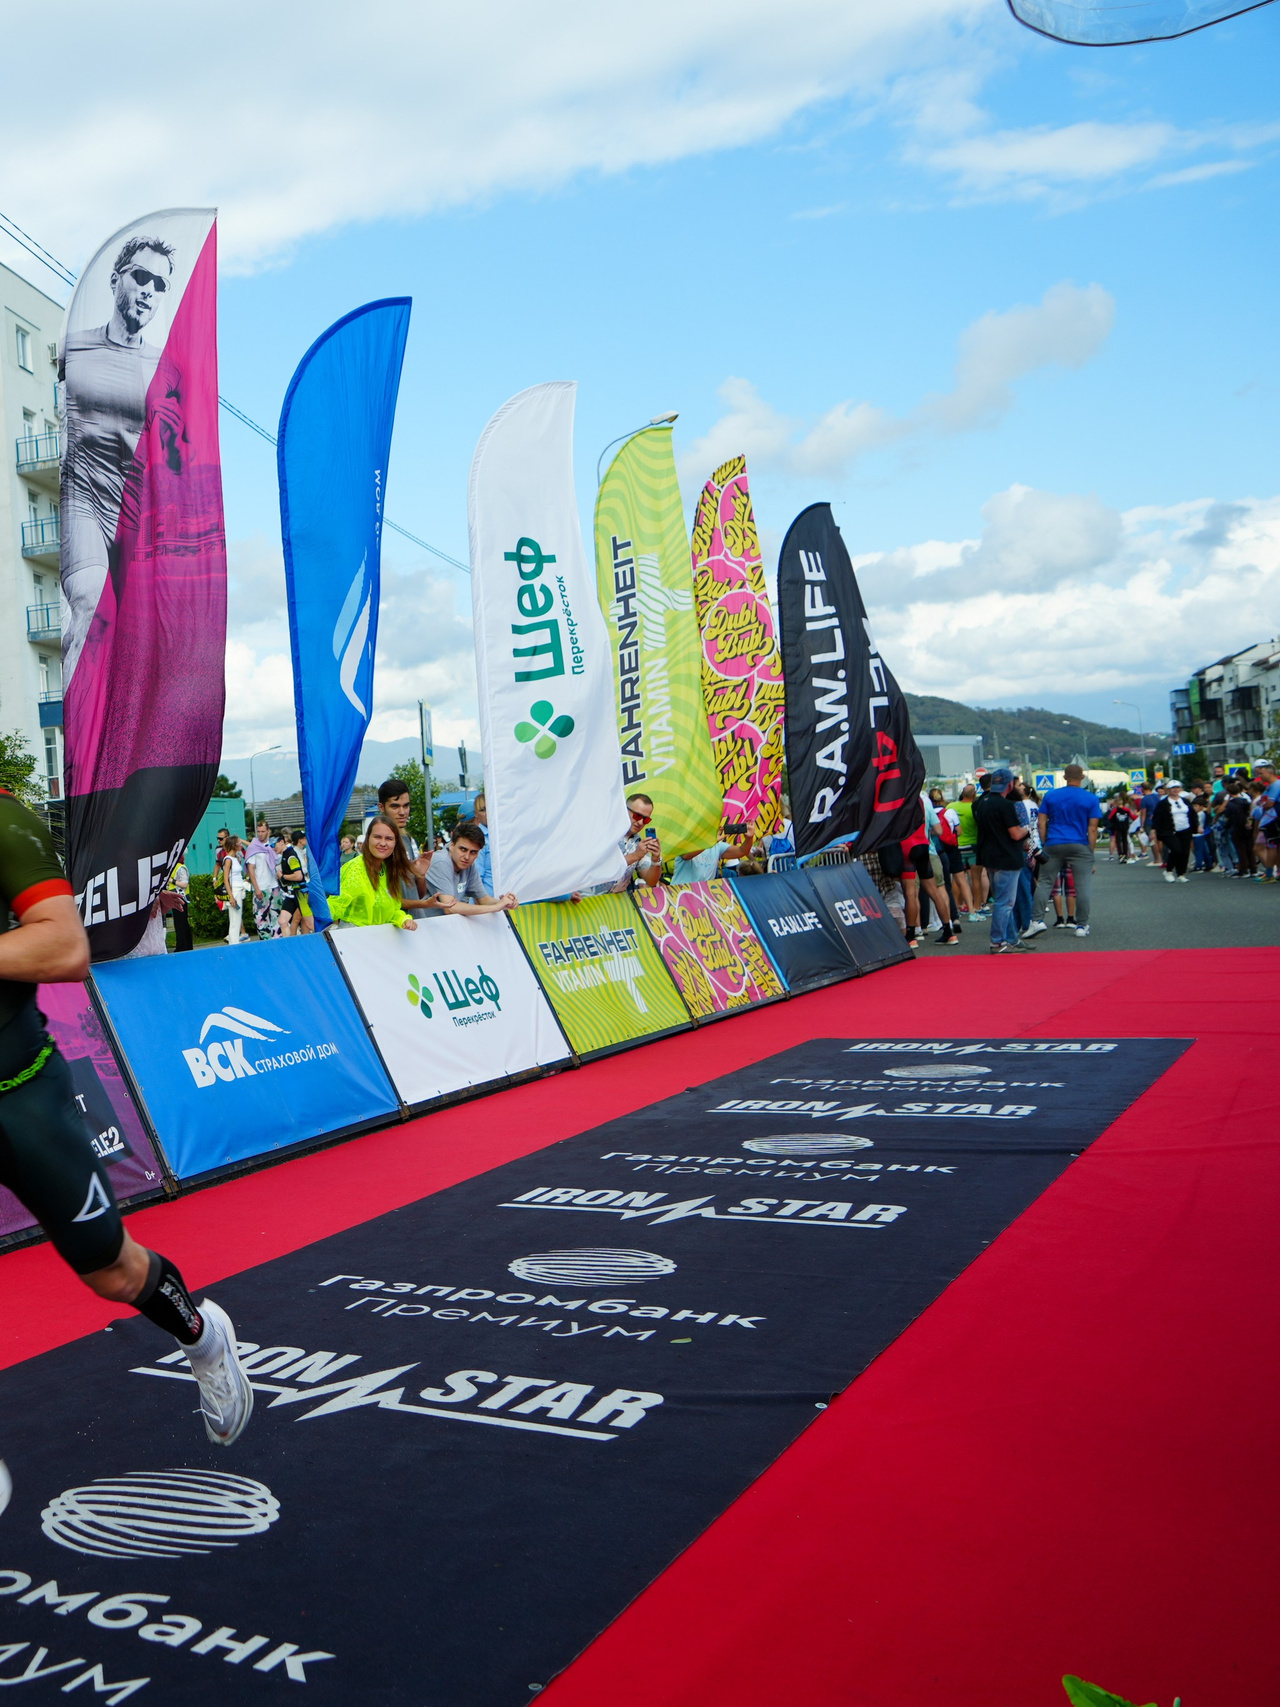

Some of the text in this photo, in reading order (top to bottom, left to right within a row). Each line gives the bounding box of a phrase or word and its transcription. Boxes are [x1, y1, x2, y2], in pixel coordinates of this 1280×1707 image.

[504, 537, 565, 682] Шеф
[555, 575, 584, 675] Перекрёсток
[704, 600, 758, 640] Dubl
[611, 535, 646, 785] FAHRENHEIT
[714, 622, 775, 668] Bubl
[799, 549, 850, 824] R.A.W.LIFE
[644, 657, 675, 776] VITAMIN
[678, 906, 717, 941] Dubl
[834, 896, 882, 927] GEL4U
[537, 927, 639, 967] FAHRENHEIT
[432, 965, 502, 1011] Шеф
[552, 963, 608, 994] VITAMIN
[452, 1011, 496, 1027] Перекрёсток
[182, 1038, 340, 1089] ВСК СТРАХОВОЙ ДОМ
[848, 1043, 1118, 1052] IRON STAR
[770, 1079, 1066, 1088] Газпромбанк
[716, 1100, 1038, 1117] IRON STAR
[90, 1126, 125, 1158] ELE2
[144, 1170, 156, 1181] 0+
[600, 1152, 958, 1174] Газпромбанк
[632, 1163, 880, 1182] Премиум
[513, 1188, 908, 1223] IRON STAR
[318, 1275, 767, 1329] Газпромбанк
[344, 1297, 658, 1341] Премиум
[420, 1369, 665, 1428] STAR
